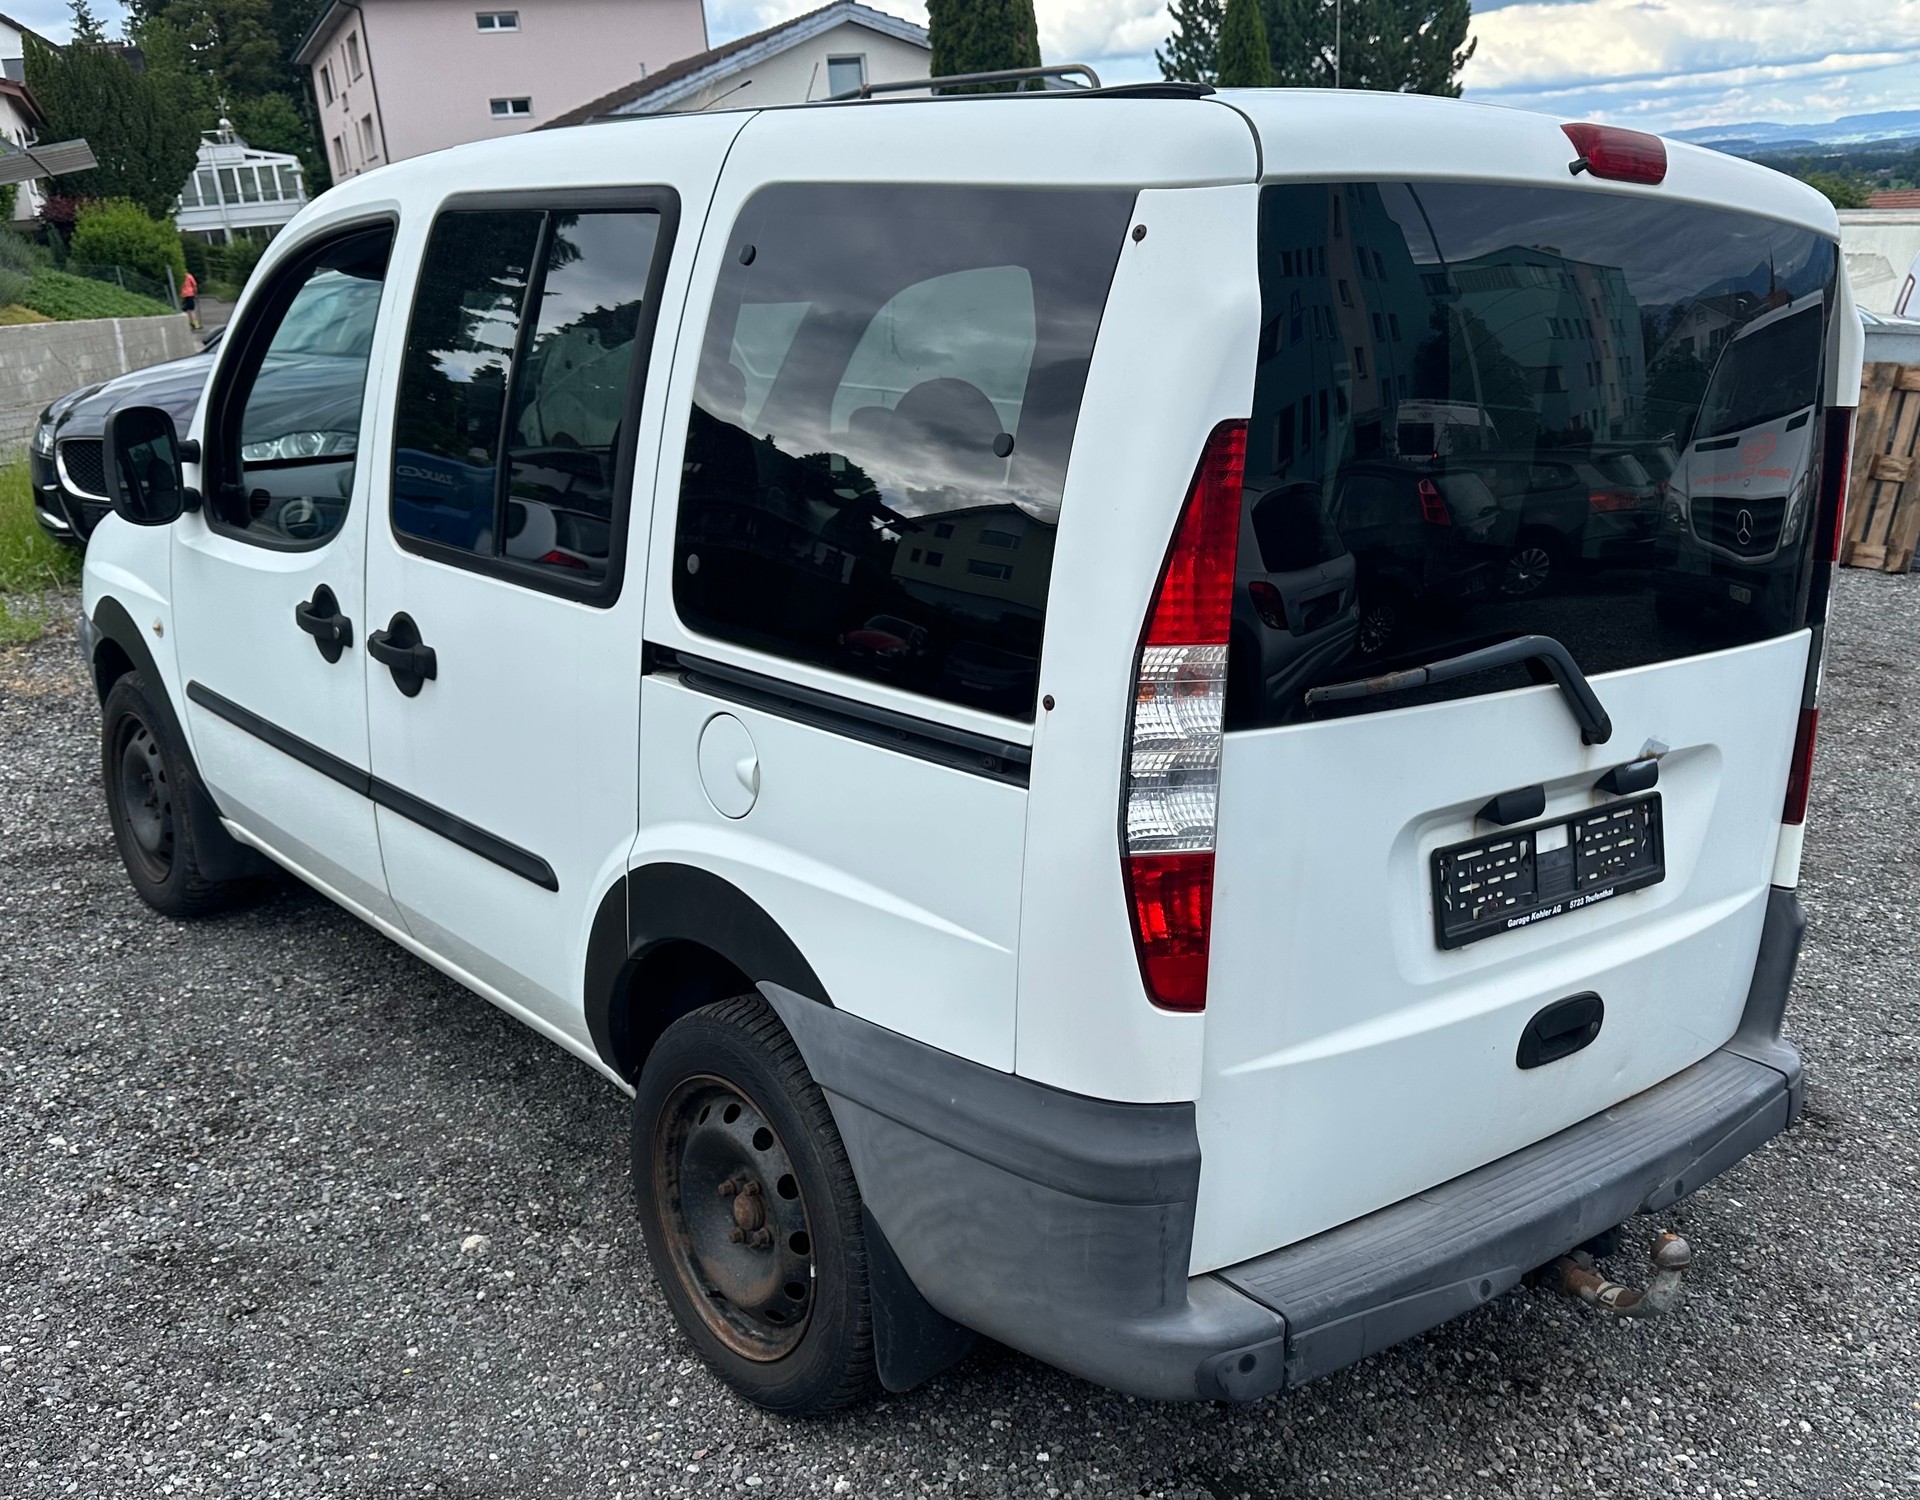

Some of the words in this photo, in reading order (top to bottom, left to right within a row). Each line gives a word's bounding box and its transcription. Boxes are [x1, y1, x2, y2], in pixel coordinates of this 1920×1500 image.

[1507, 915, 1530, 928] Garage
[1531, 908, 1552, 921] Kohler
[1552, 904, 1562, 915] AG
[1569, 897, 1584, 909] 5723
